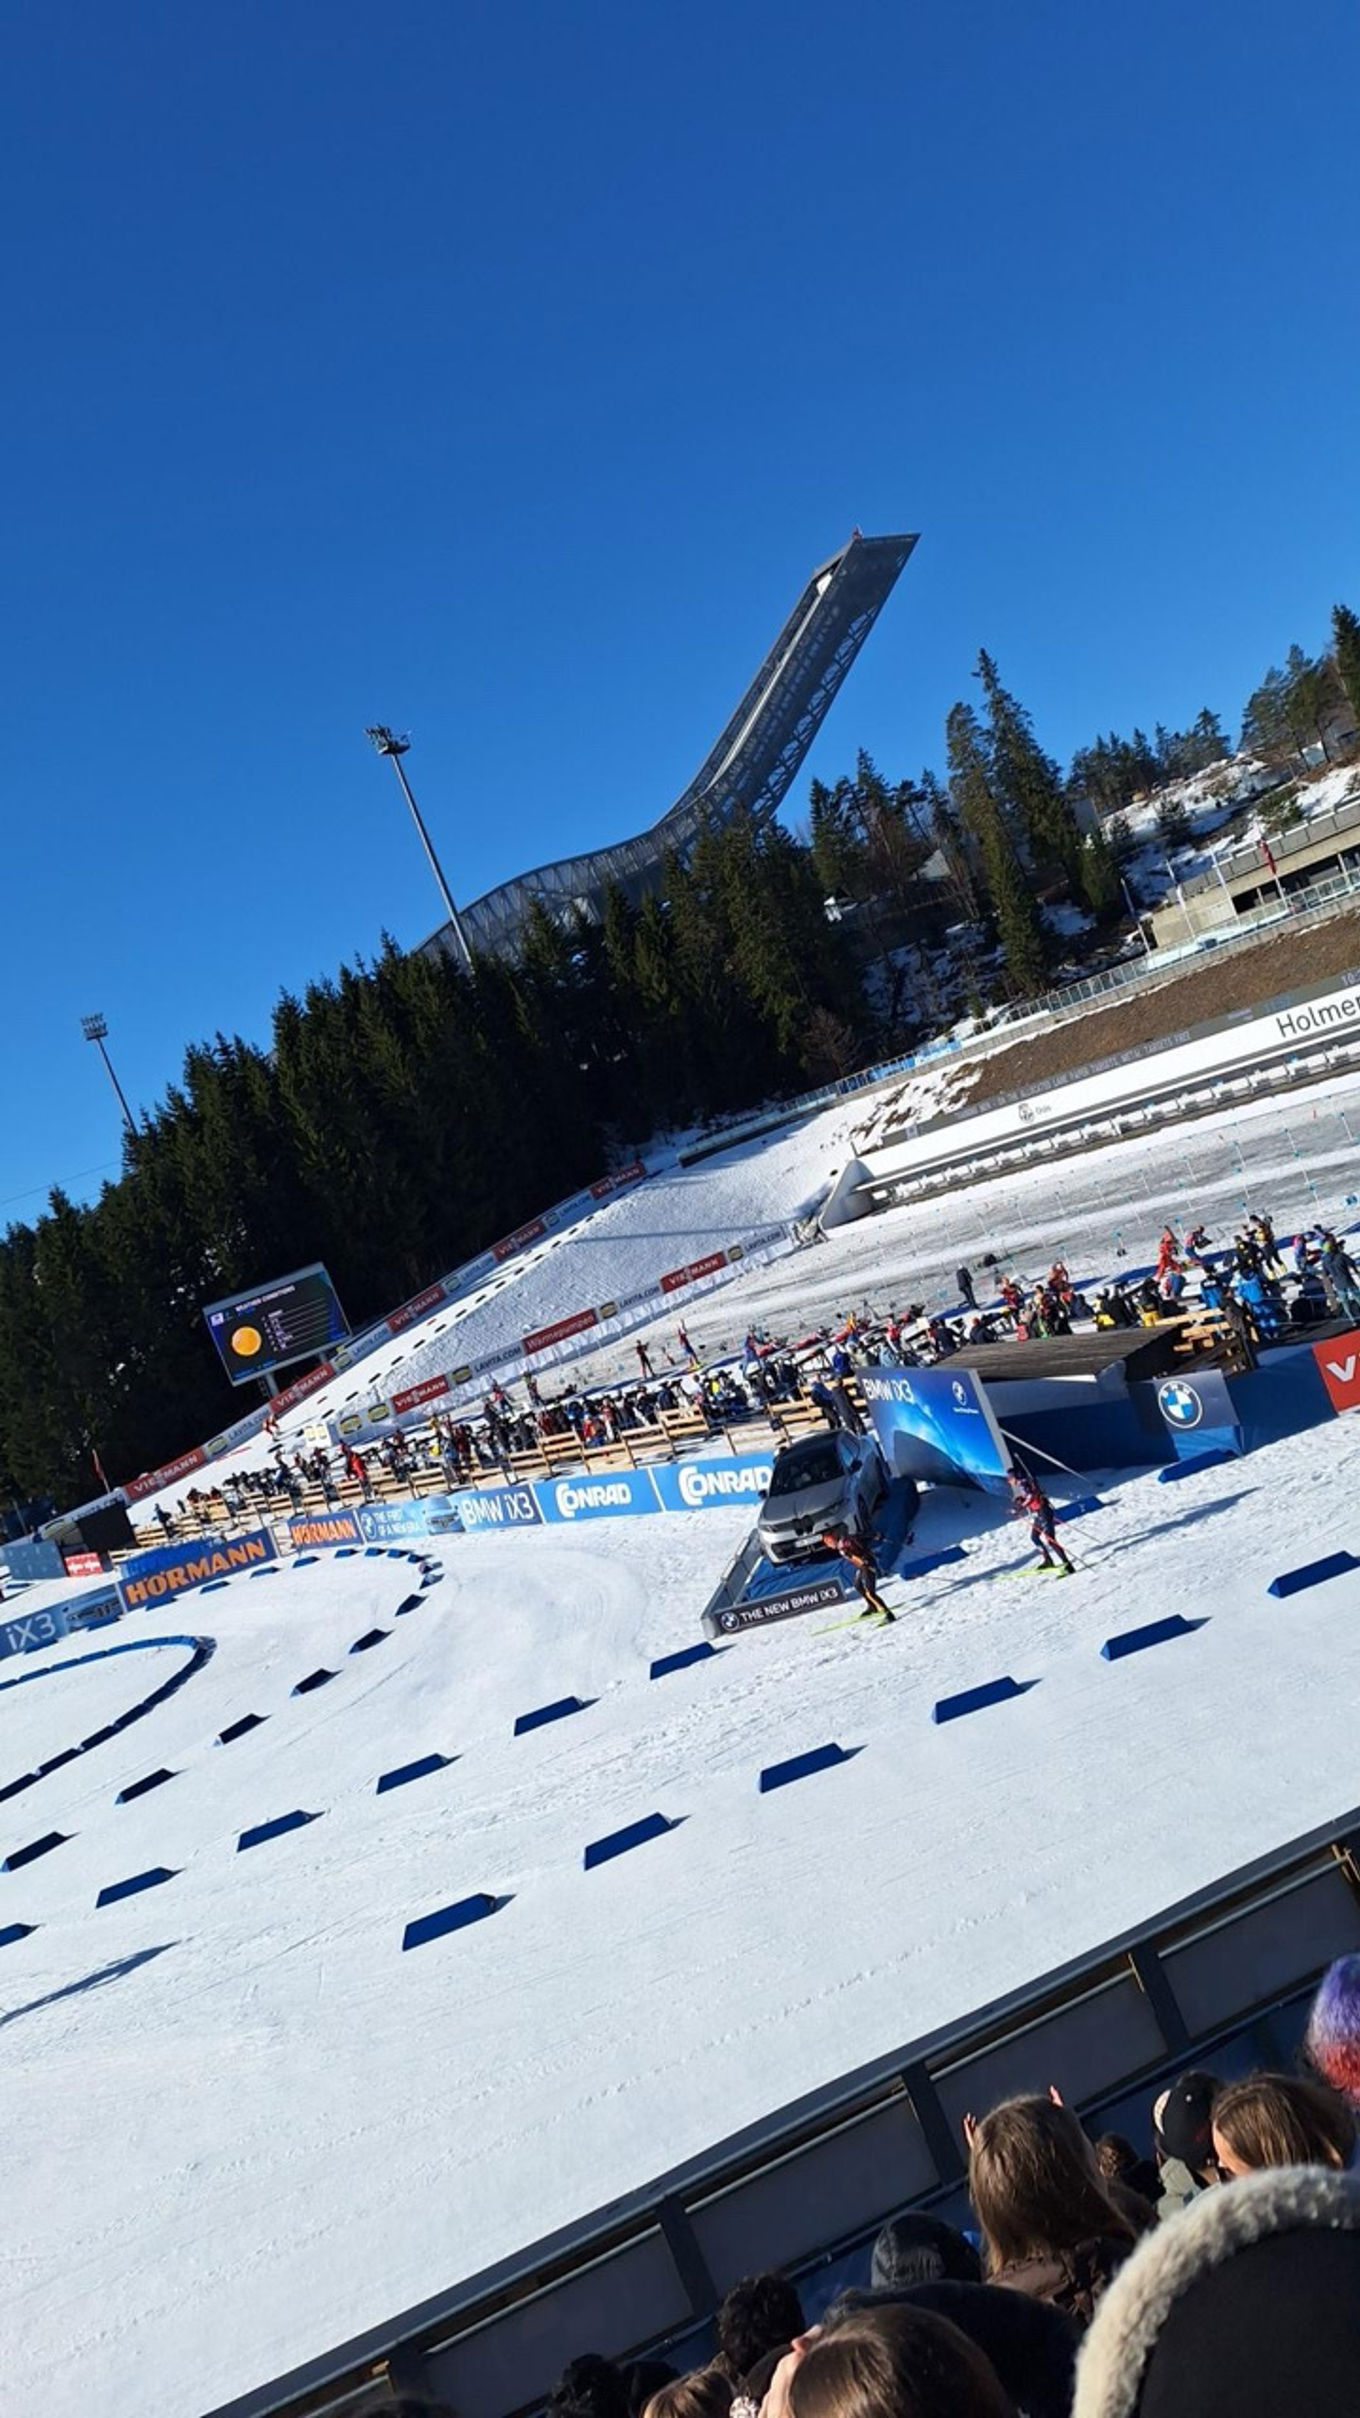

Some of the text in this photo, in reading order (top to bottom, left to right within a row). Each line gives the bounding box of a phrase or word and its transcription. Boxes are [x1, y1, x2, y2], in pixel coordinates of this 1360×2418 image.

[474, 1346, 521, 1373] LAVITA.COM
[862, 1378, 893, 1401] BMW
[555, 1482, 632, 1518] CONRAD
[679, 1465, 773, 1506] CONRAD
[462, 1491, 535, 1525] BMW iX3
[125, 1538, 266, 1604] HÖRMANN
[741, 1586, 839, 1623] THE NEW BMW iX3
[7, 1613, 56, 1651] iX3
